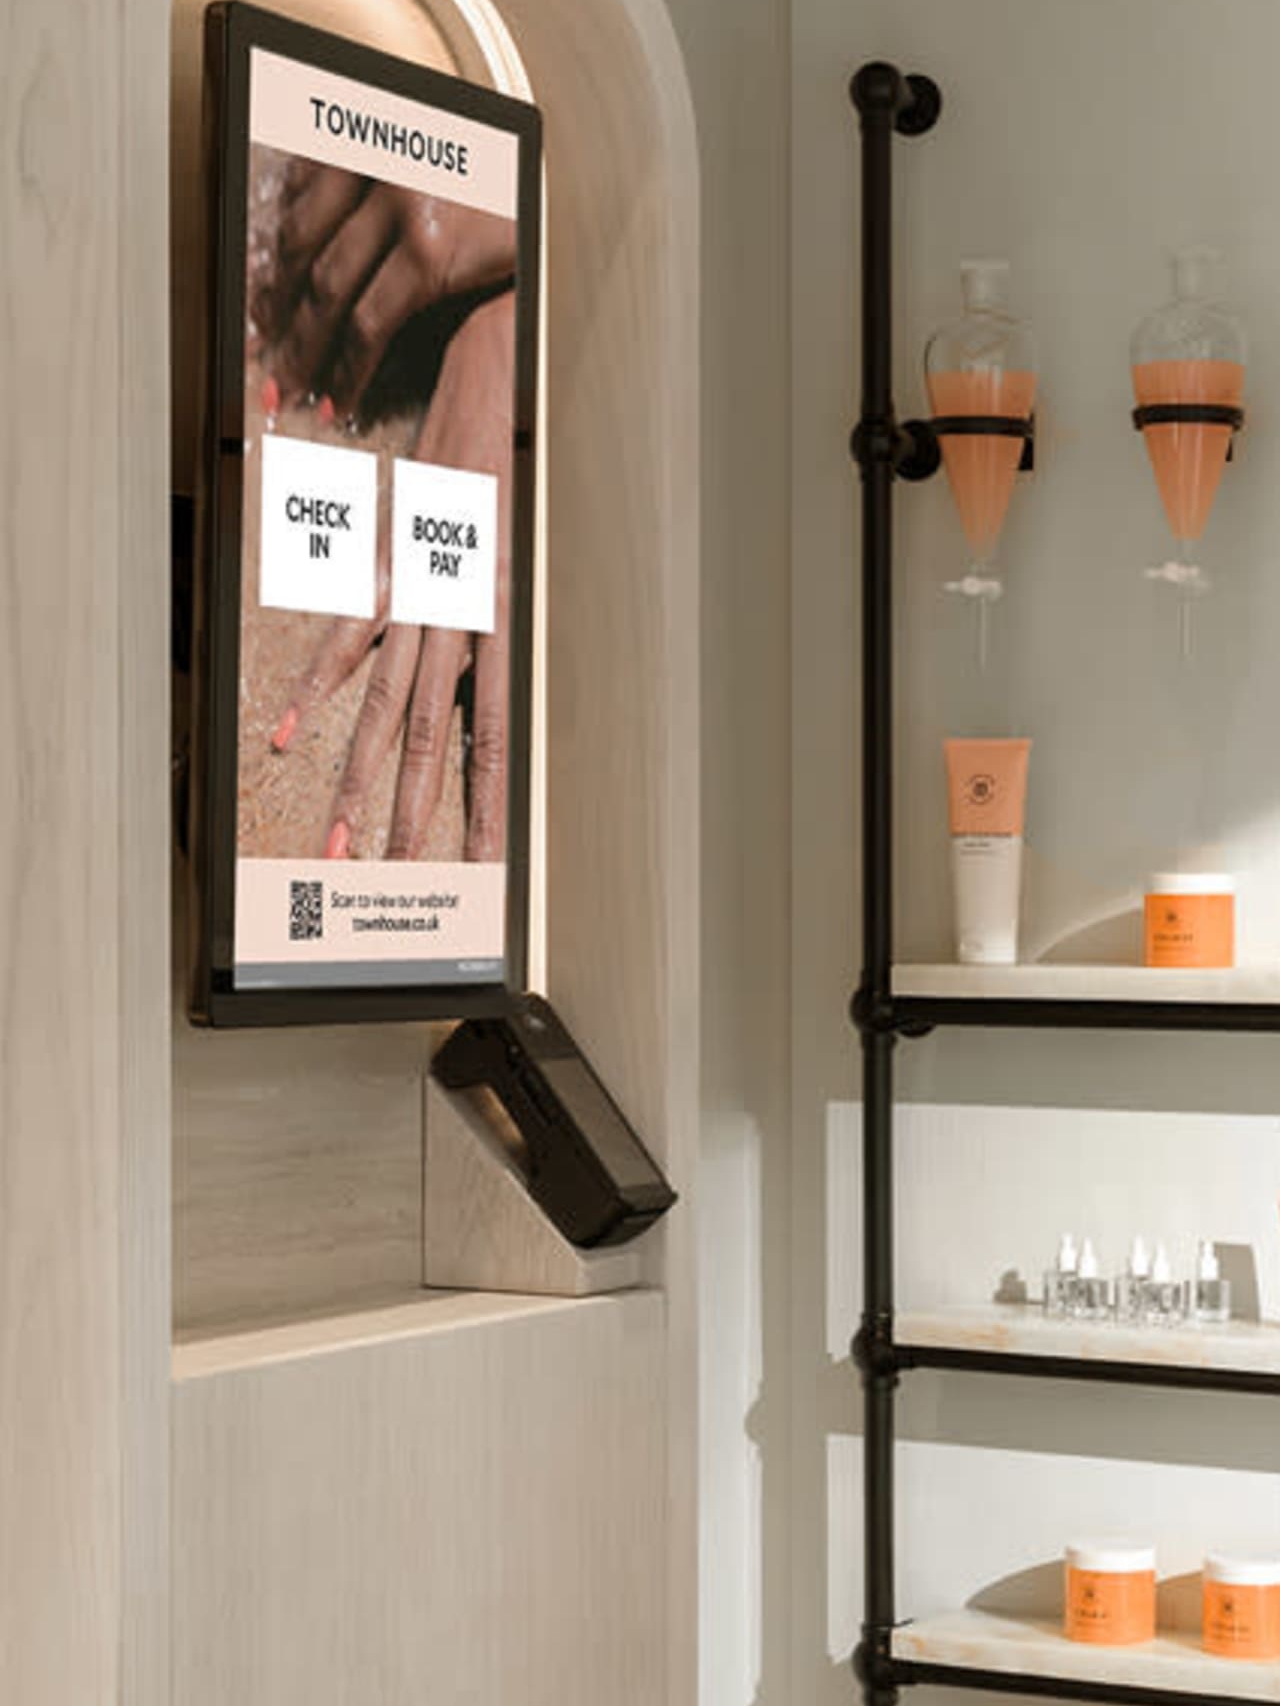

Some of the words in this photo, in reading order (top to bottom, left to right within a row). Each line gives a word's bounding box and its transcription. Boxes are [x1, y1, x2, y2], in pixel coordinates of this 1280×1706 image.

[309, 97, 469, 175] TOWNHOUSE
[285, 495, 351, 530] CHECK
[310, 533, 330, 559] IN
[413, 515, 463, 547] BOOK
[466, 523, 478, 549] &
[429, 550, 463, 577] PAY
